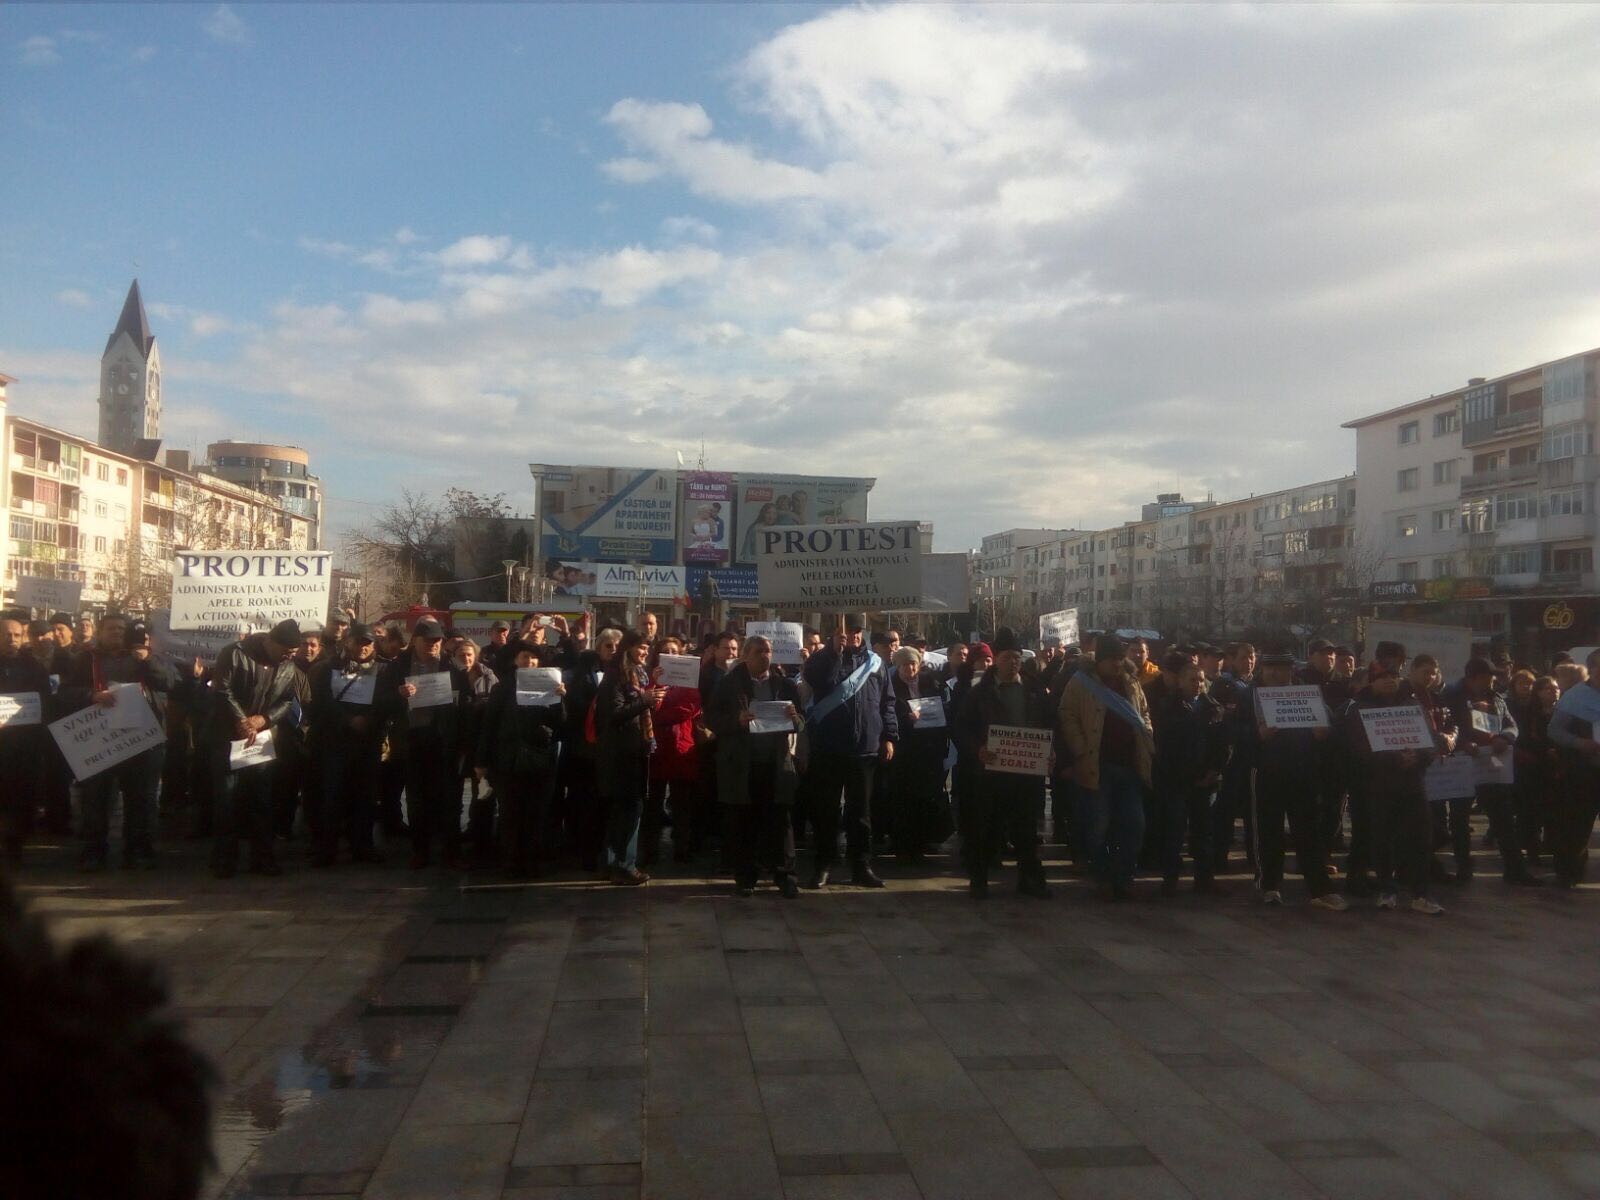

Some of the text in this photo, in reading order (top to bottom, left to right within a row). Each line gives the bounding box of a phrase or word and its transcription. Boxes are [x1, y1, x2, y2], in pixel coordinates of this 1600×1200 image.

[615, 510, 672, 520] APARTAMENT
[762, 526, 918, 554] PROTEST
[182, 555, 331, 577] PROTEST
[800, 571, 830, 582] APELE
[800, 585, 816, 597] NU
[207, 598, 243, 608] APELE
[181, 612, 190, 622] A
[1000, 759, 1037, 769] EGALE
